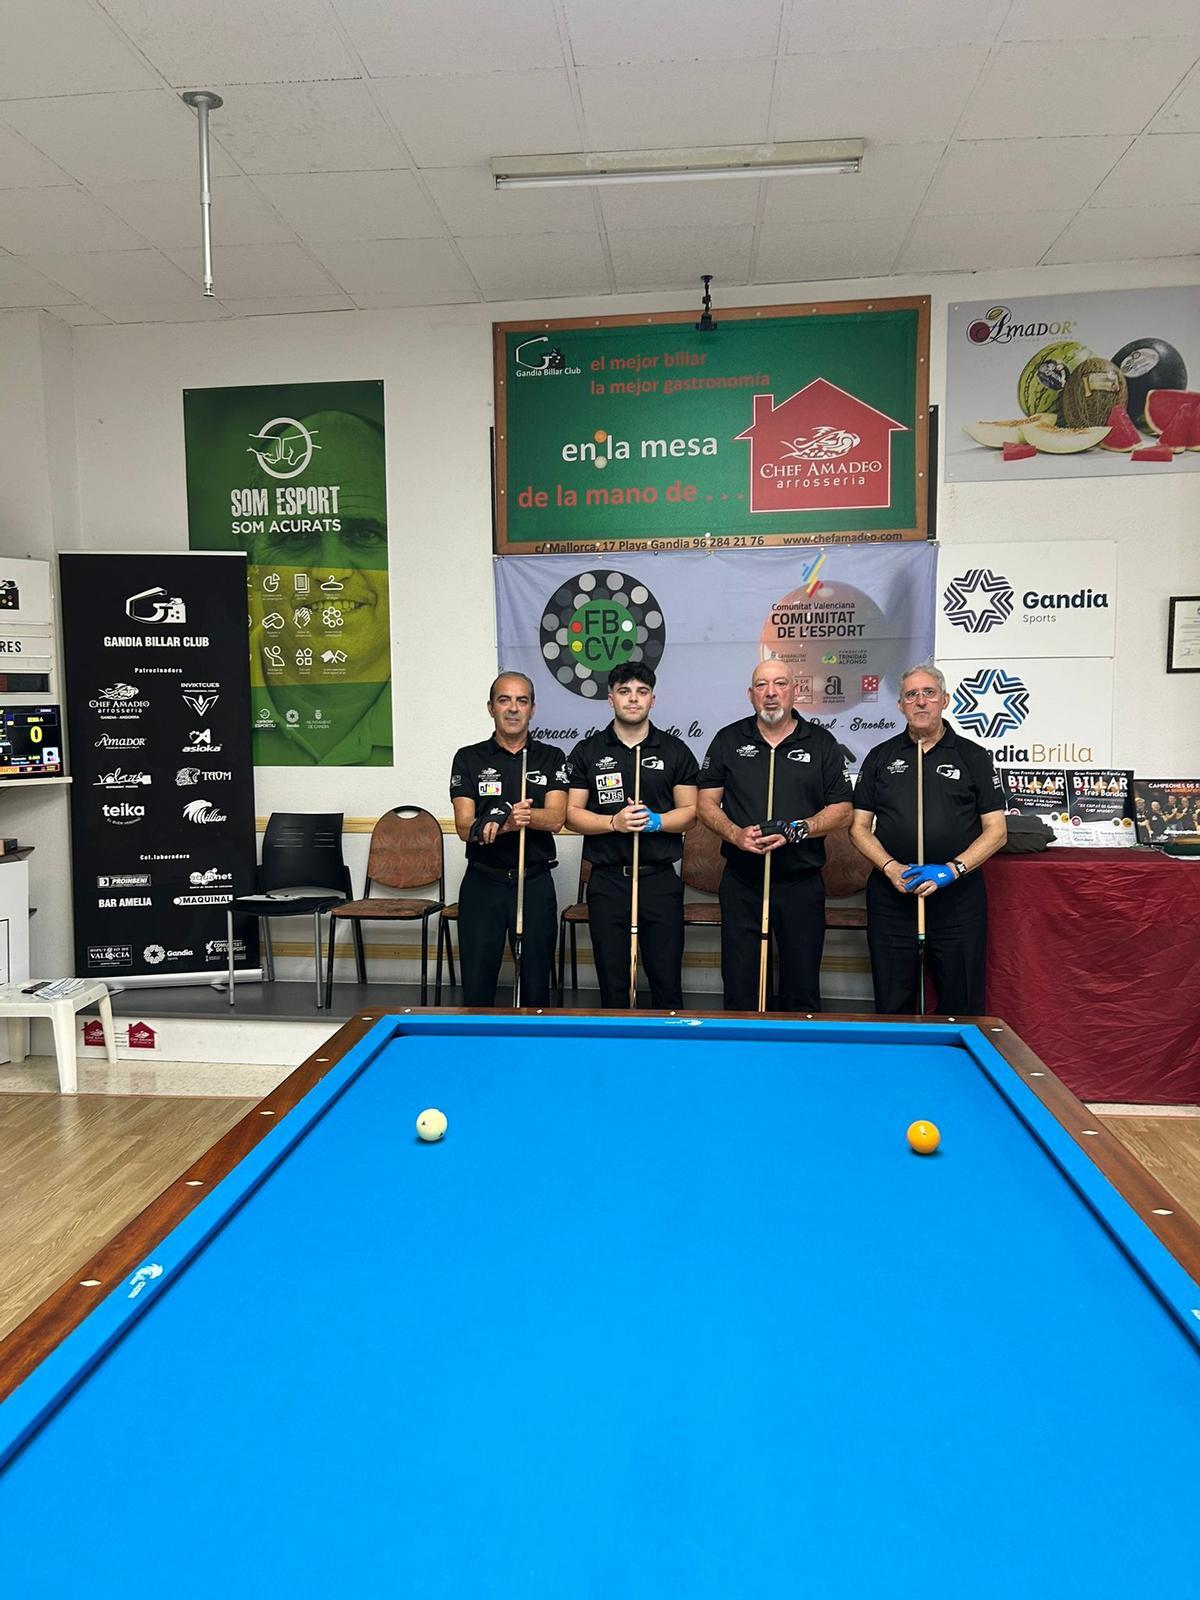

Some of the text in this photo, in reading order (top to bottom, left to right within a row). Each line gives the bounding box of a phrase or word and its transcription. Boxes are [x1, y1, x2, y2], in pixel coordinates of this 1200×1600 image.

[590, 351, 708, 372] el mejor billar
[516, 367, 581, 377] Gandia Billar Club
[590, 371, 770, 396] la mejor gastronomía
[562, 435, 718, 462] en la mesa
[760, 461, 882, 479] CHEF AMADEO
[776, 474, 865, 489] arrosseria
[230, 486, 341, 517] SOM ESPORT
[518, 486, 548, 509] de
[556, 484, 577, 507] la
[586, 486, 658, 505] mano
[666, 480, 698, 503] de
[231, 518, 342, 534] SOM ACURATS
[603, 541, 615, 551] 17
[619, 540, 648, 553] Playa
[650, 539, 690, 549] Gandia
[693, 538, 706, 548] 96
[709, 537, 730, 547] 284
[734, 536, 747, 546] 21
[751, 536, 764, 546] 76
[783, 532, 903, 545] www.chefamadeo.com
[772, 601, 855, 611] Comunitat Valenciana
[1022, 589, 1109, 609] Gandia
[584, 610, 620, 635] FB
[771, 611, 855, 626] COMUNITAT
[1022, 613, 1057, 624] Sports
[777, 624, 866, 639] DE L'ESPORT
[103, 636, 210, 648] GANDIA BILLAR CLUB
[584, 637, 620, 661] CV
[88, 699, 150, 709] CHEF AMADEO
[30, 725, 43, 744] 0
[530, 726, 580, 740] deració
[688, 720, 704, 738] la
[849, 717, 896, 732] Snooker
[1008, 775, 1065, 790] BILLAR
[1073, 776, 1128, 790] BILLAR
[1083, 788, 1099, 797] Tres
[1100, 789, 1128, 798] Bandas
[102, 802, 145, 817] teika
[98, 897, 153, 908] BAR AMELIA
[182, 895, 231, 904] MAQUINAL
[90, 951, 130, 960] VALENCIA
[166, 949, 194, 957] Gandia
